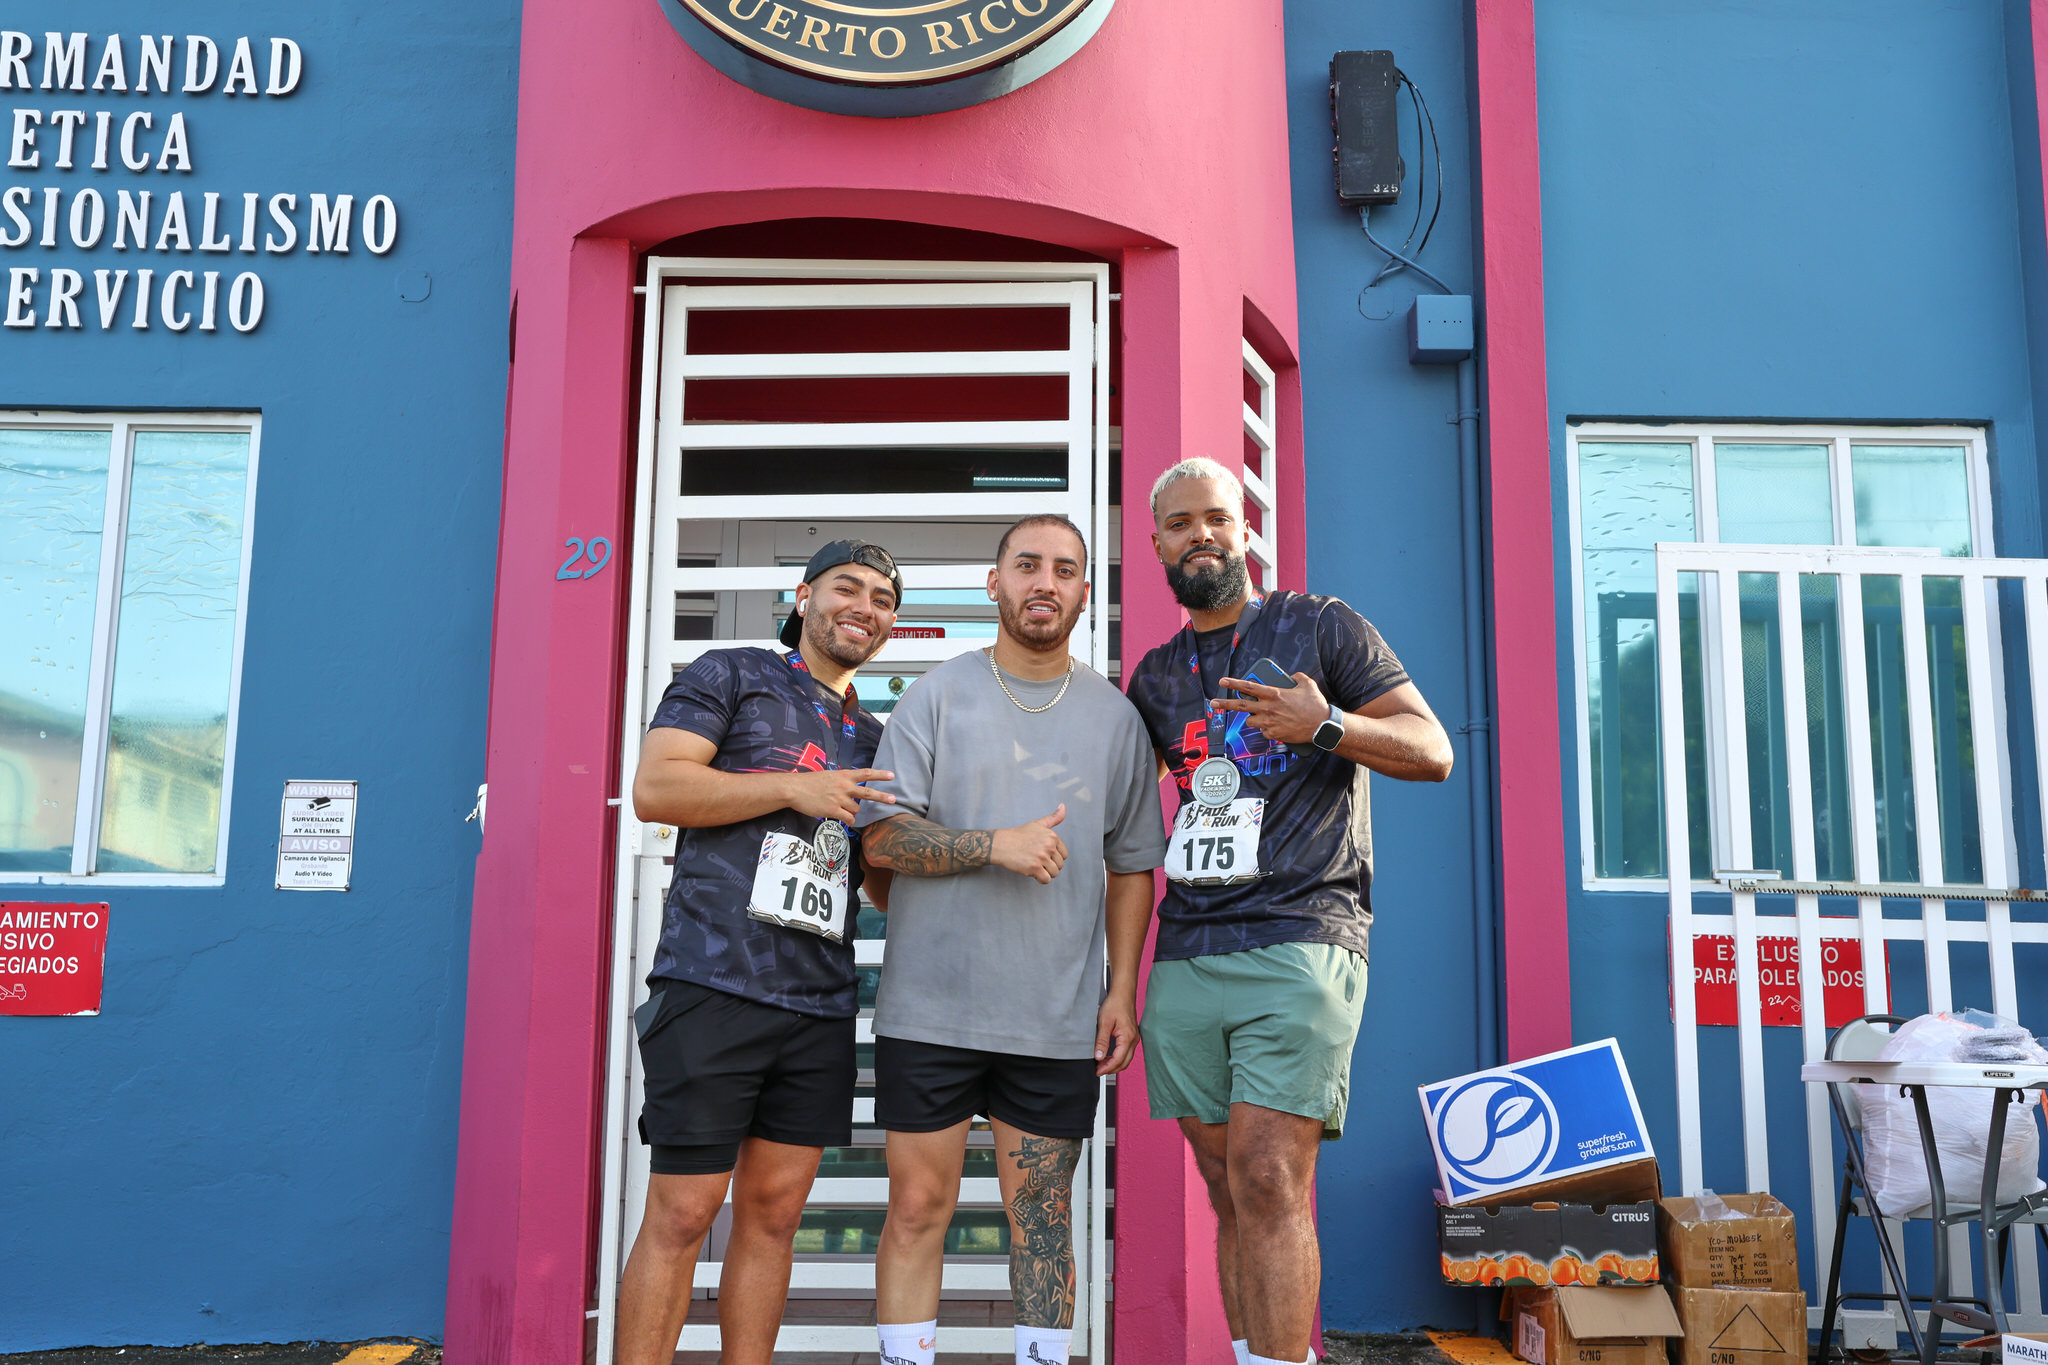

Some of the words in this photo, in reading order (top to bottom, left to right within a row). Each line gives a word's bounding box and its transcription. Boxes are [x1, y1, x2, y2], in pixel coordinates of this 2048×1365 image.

[728, 0, 907, 60] UERTO
[922, 0, 1048, 55] RICO
[8, 109, 193, 172] ETICA
[1373, 184, 1399, 193] 325
[0, 187, 398, 254] SIONALISMO
[4, 267, 265, 332] ERVICIO
[557, 536, 612, 580] 29
[1201, 775, 1226, 787] 5K
[287, 786, 352, 796] WARNING
[1196, 803, 1232, 817] FADE
[1202, 817, 1210, 827] &
[1211, 815, 1240, 828] RUN
[290, 838, 342, 851] AVISO
[1182, 836, 1235, 872] 175
[812, 864, 832, 882] RUN
[781, 876, 833, 923] 169
[0, 911, 99, 929] AMIENTO
[1694, 967, 1737, 984] PARA
[1768, 995, 1782, 1006] 22
[1577, 1131, 1627, 1149] superfresh
[1580, 1140, 1637, 1160] growers.com
[1611, 1212, 1650, 1222] CITRUS
[1580, 1349, 1601, 1362] C/NO
[1711, 1352, 1735, 1365] C/NO
[2007, 1343, 2047, 1360] MARATH
